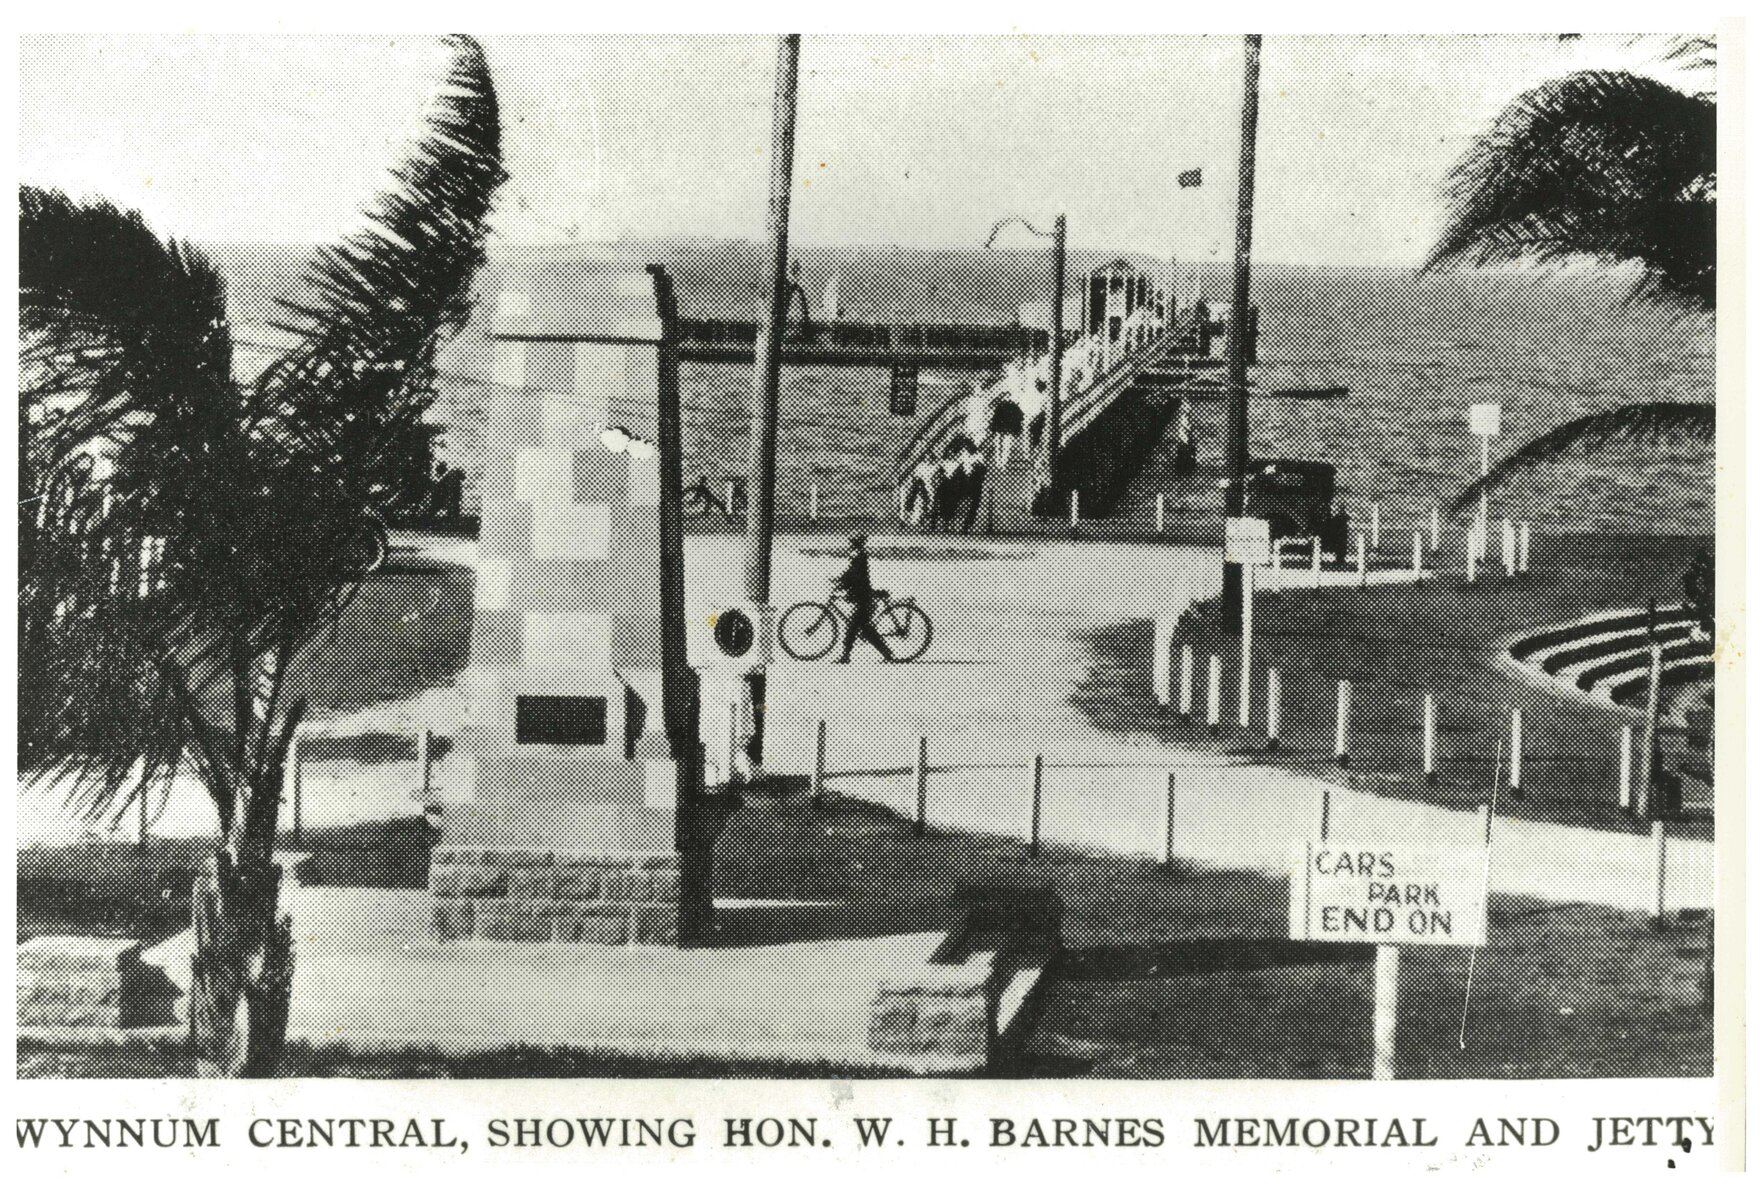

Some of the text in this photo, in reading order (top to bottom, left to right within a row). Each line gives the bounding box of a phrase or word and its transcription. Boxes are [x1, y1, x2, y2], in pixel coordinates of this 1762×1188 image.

[1316, 851, 1396, 878] CARS
[1368, 881, 1441, 907] PARK
[1321, 906, 1452, 936] END ON
